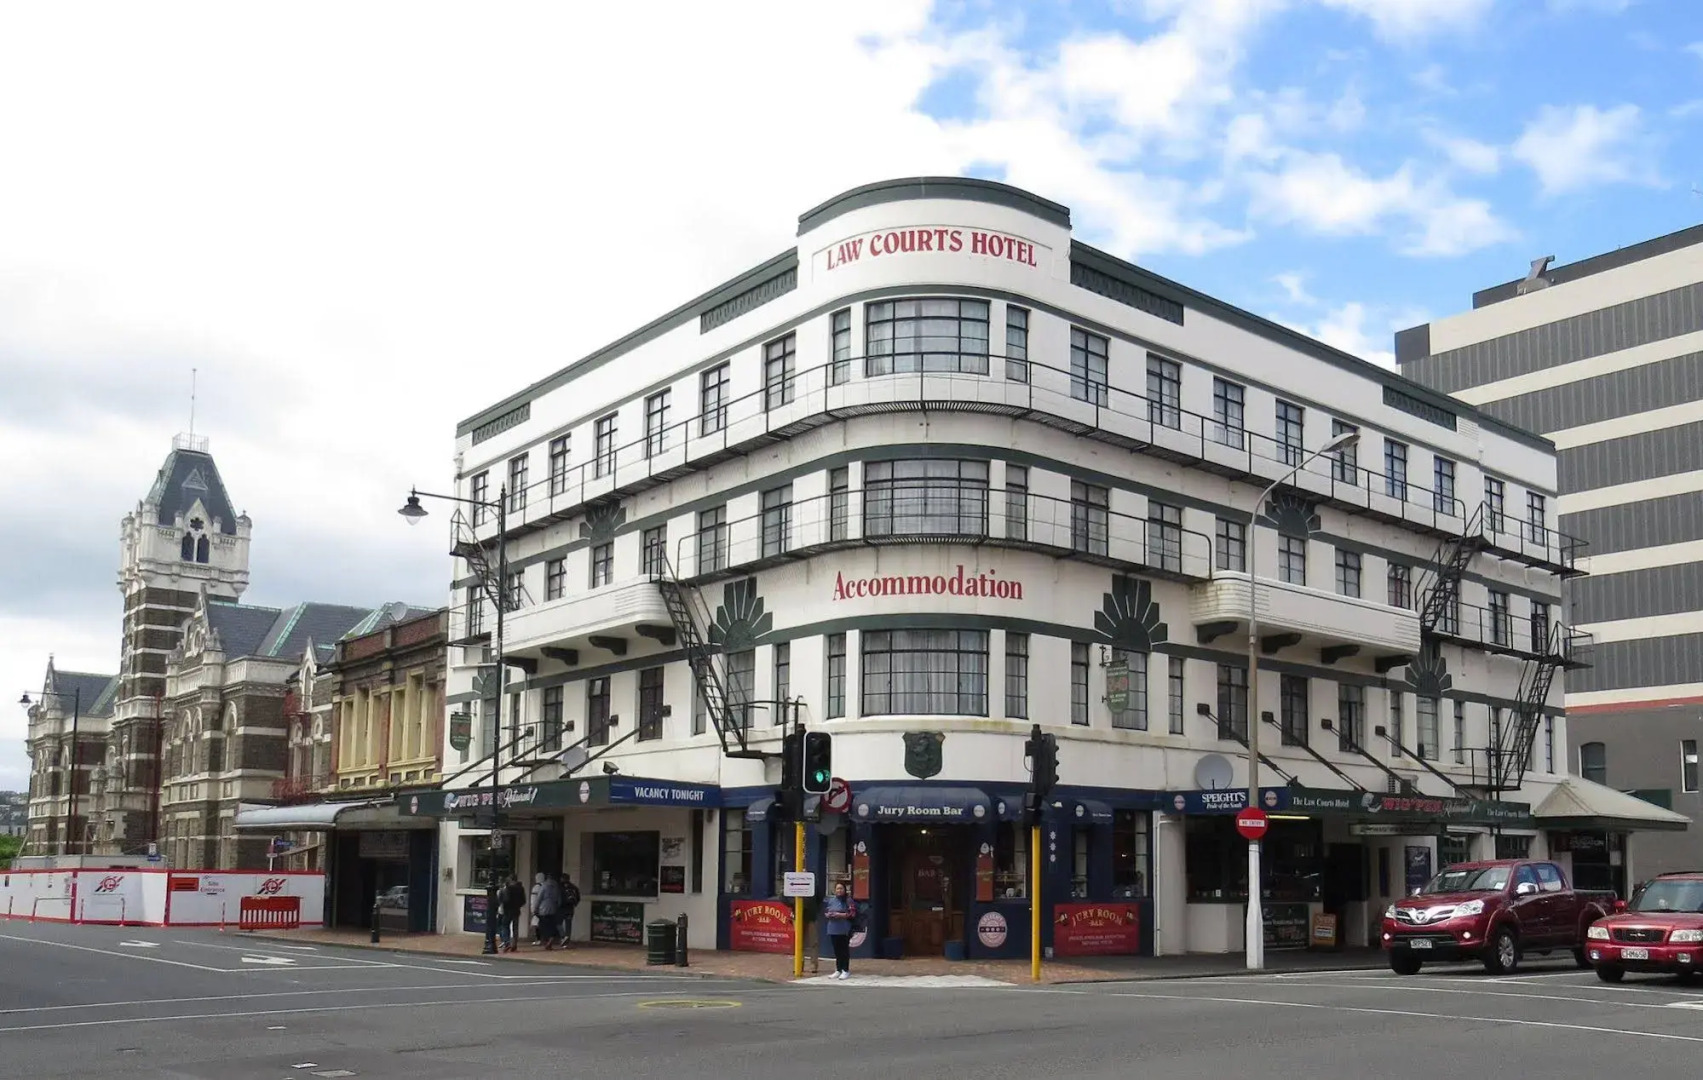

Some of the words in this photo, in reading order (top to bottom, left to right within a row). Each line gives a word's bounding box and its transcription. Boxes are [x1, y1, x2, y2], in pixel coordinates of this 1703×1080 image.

[827, 239, 864, 271] LAW
[869, 229, 963, 257] COURTS
[971, 232, 1037, 268] HOTEL
[833, 565, 1024, 601] Accommodation
[634, 787, 669, 799] VACANCY
[671, 789, 704, 800] TONIGHT
[1201, 792, 1246, 803] SPEIGHT'S
[1293, 797, 1303, 805] The
[1304, 797, 1315, 806] Law
[1335, 799, 1350, 808] Hotel
[877, 806, 905, 816] Jury
[907, 806, 941, 815] Room
[943, 806, 964, 815] Bar
[744, 905, 763, 921] JURY
[764, 905, 787, 924] ROOM
[1072, 909, 1094, 927] JURY
[1097, 909, 1122, 926] ROOM
